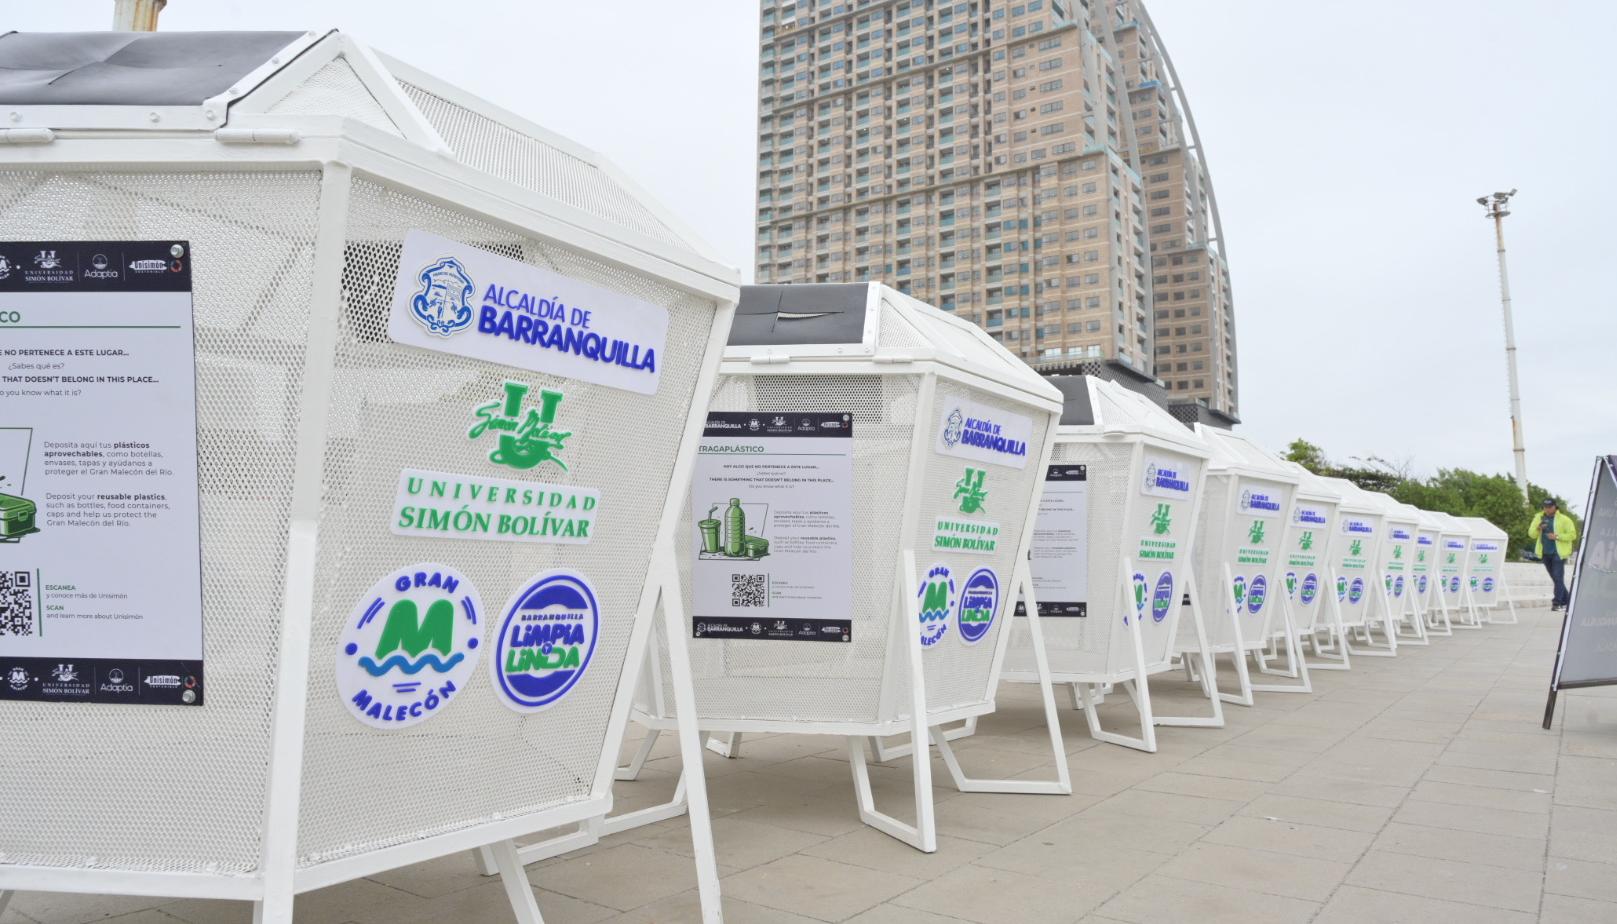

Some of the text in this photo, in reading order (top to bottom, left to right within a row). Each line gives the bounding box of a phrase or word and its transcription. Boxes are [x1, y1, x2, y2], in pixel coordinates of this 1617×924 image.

[84, 269, 118, 279] Adaptia
[483, 283, 592, 329] ALCALDÍA DE
[477, 304, 655, 373] BARRANQUILLA
[8, 362, 35, 371] ¿Sabes
[964, 417, 1002, 435] ALCALDÍA DE
[44, 441, 78, 449] Deposita
[113, 441, 150, 449] plásticos
[961, 429, 1026, 457] BARRANQUILLA
[45, 493, 76, 501] Deposit
[406, 477, 597, 511] UNIVERSIDAD
[83, 511, 100, 519] help
[399, 504, 590, 538] SIMÓN BOLÍVAR
[937, 520, 999, 536] UNIVERSIDAD
[934, 534, 996, 551] SIMÓN BOLÍVAR
[395, 571, 460, 593] GRAN
[521, 613, 584, 621] BARRANQUILLA
[100, 683, 133, 692] Adaptia
[352, 680, 456, 721] MALECÓN
